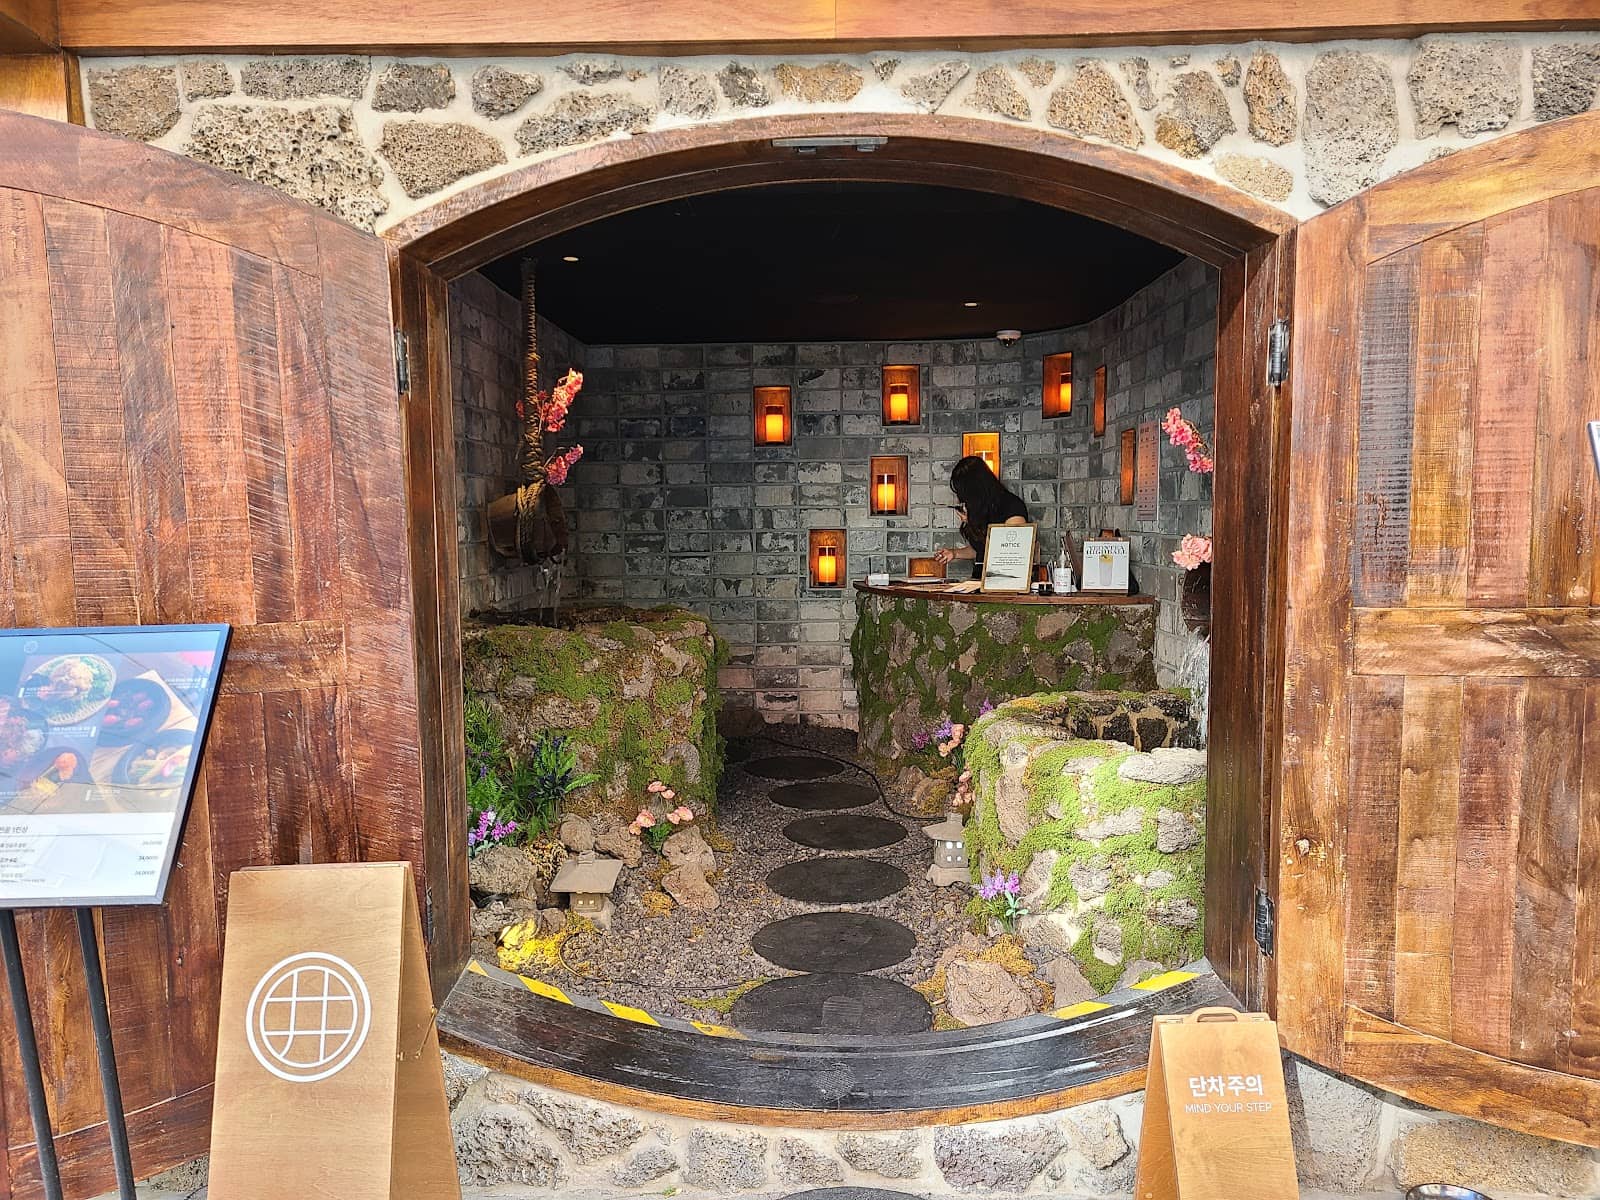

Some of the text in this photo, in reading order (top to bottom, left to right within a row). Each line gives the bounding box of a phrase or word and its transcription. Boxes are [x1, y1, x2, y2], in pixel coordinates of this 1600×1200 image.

[1185, 1102, 1272, 1113] MIND YOUR STEP
